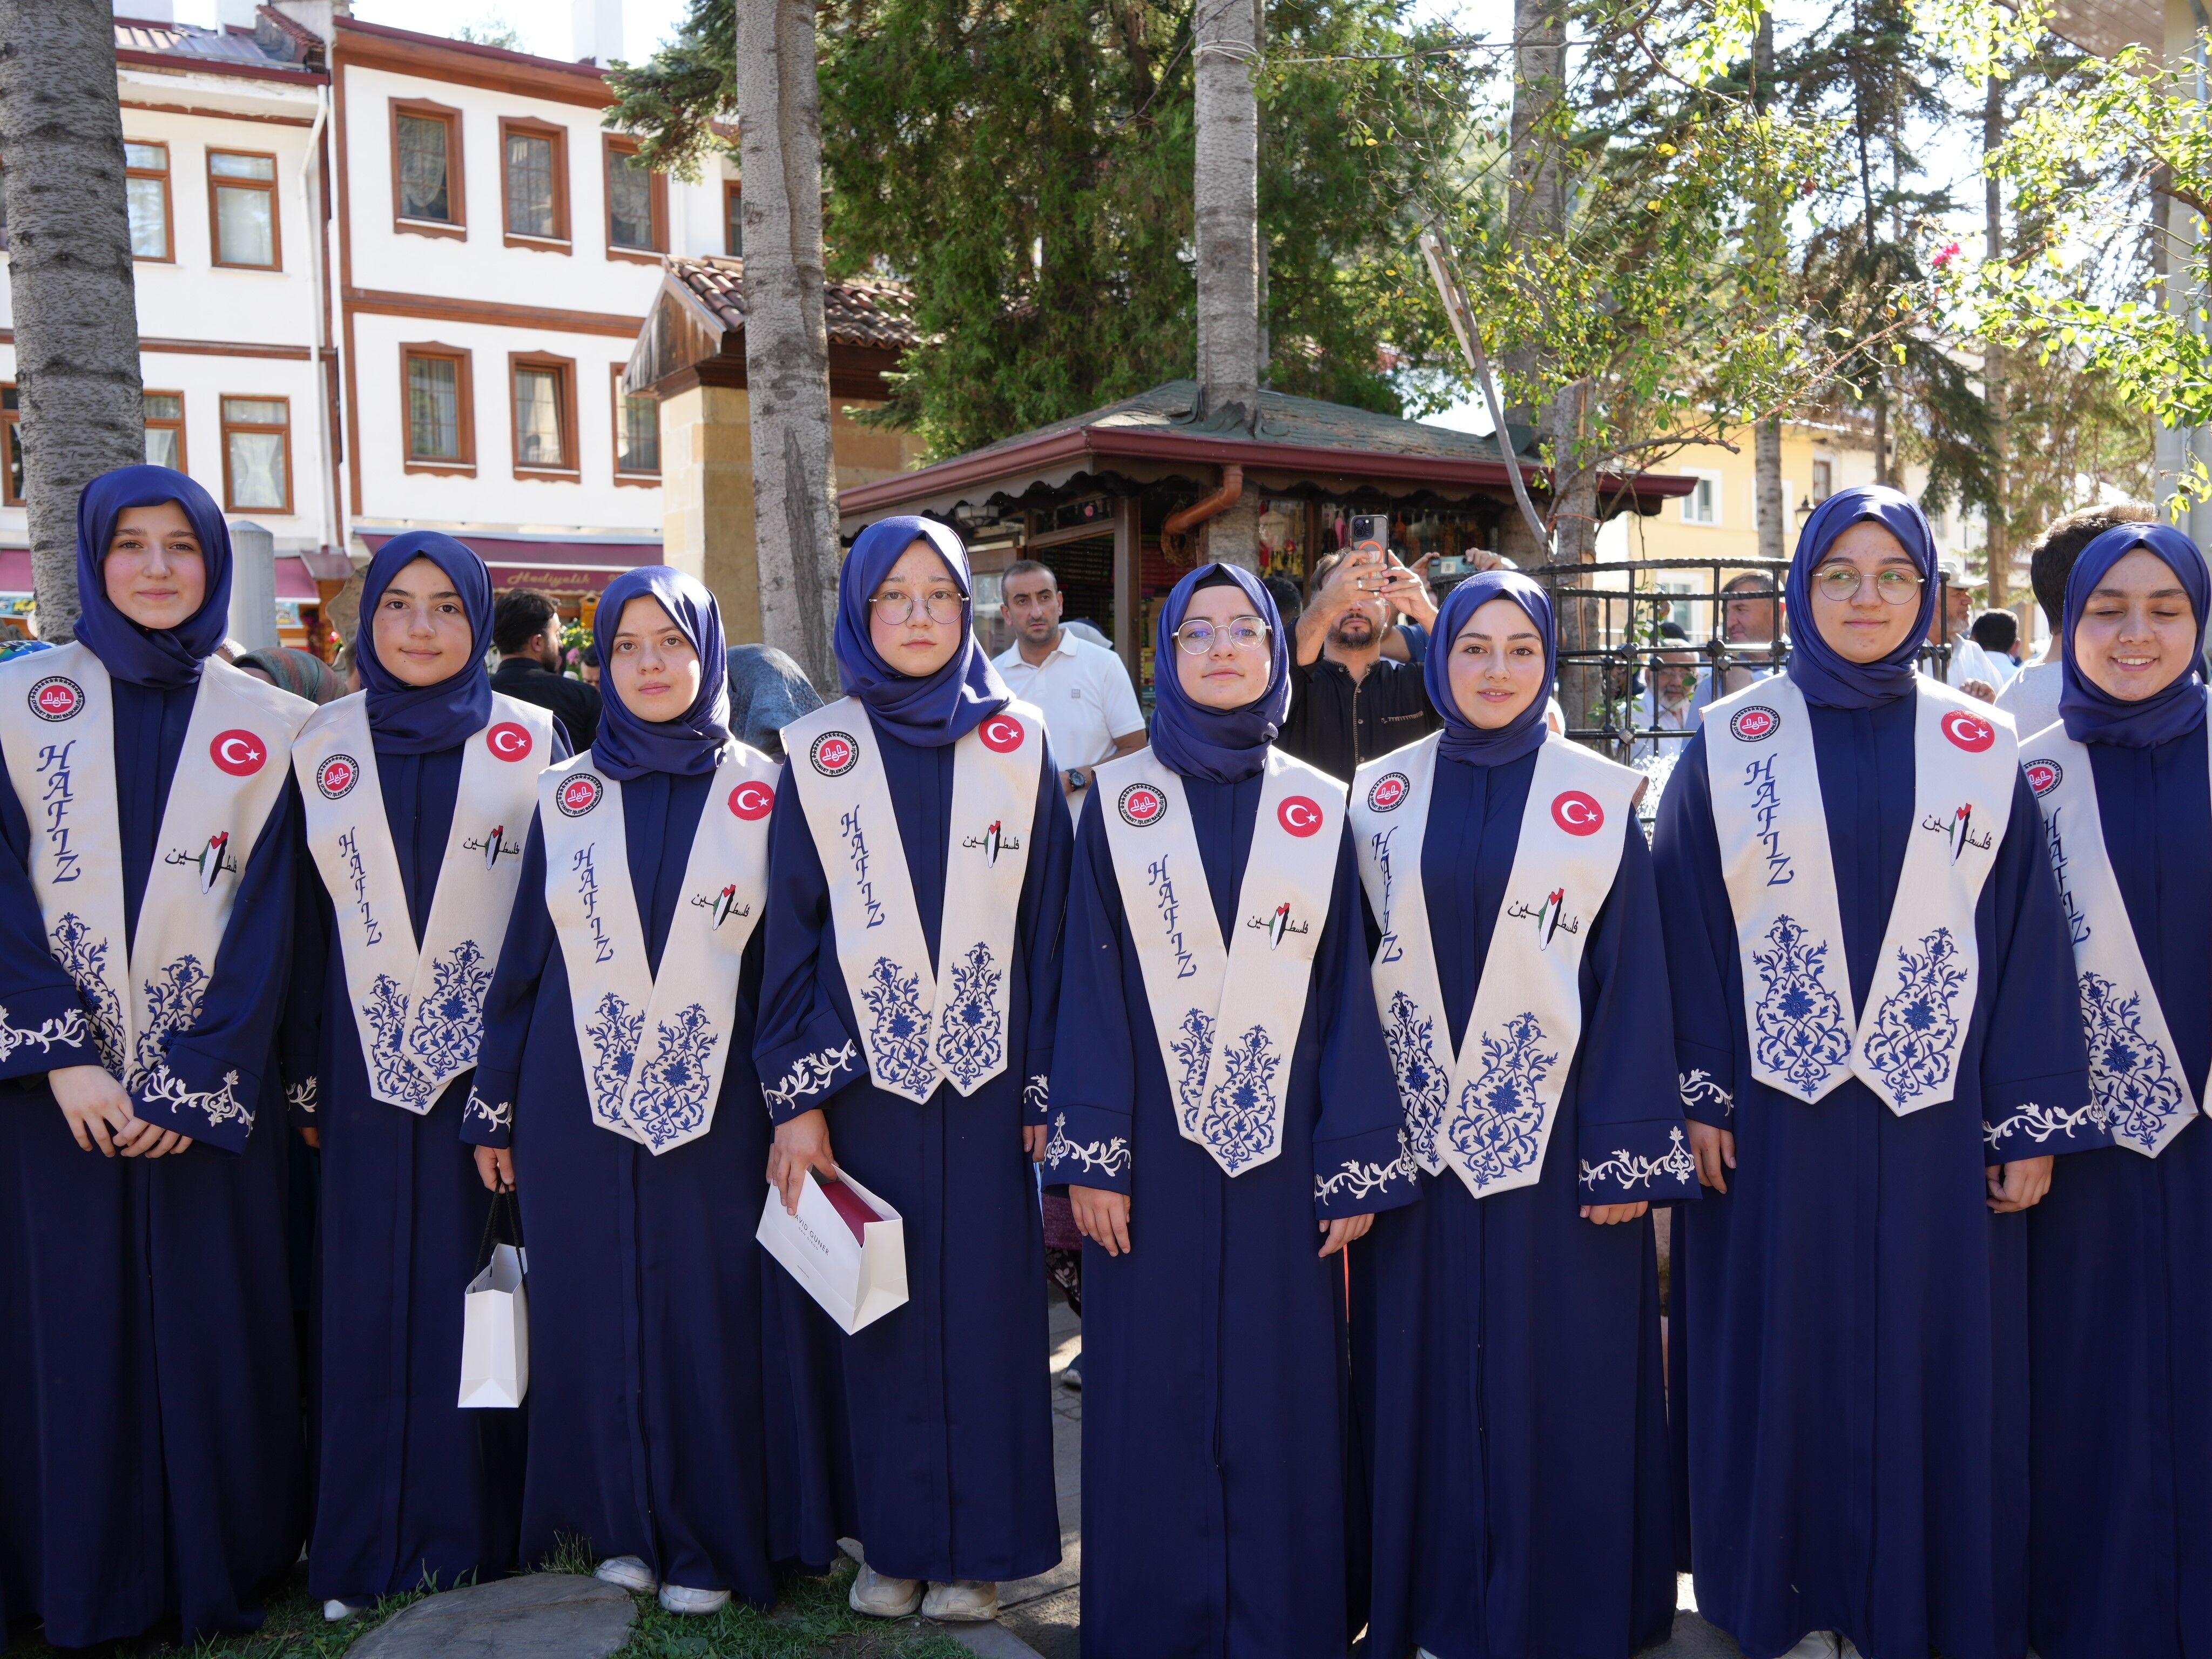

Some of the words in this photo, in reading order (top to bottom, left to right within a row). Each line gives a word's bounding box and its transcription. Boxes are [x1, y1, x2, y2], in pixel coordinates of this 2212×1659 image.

[36, 739, 81, 884] HAFIZ
[841, 804, 885, 929] HAFIZ
[1744, 753, 1794, 887] HAFIZ
[339, 826, 382, 947] HAFIZ
[572, 842, 614, 963] HAFIZ
[1148, 854, 1197, 980] HAFIZ
[1372, 826, 1403, 964] HAFIZ
[795, 1215, 808, 1230] AVID
[810, 1231, 829, 1256] GUNER
